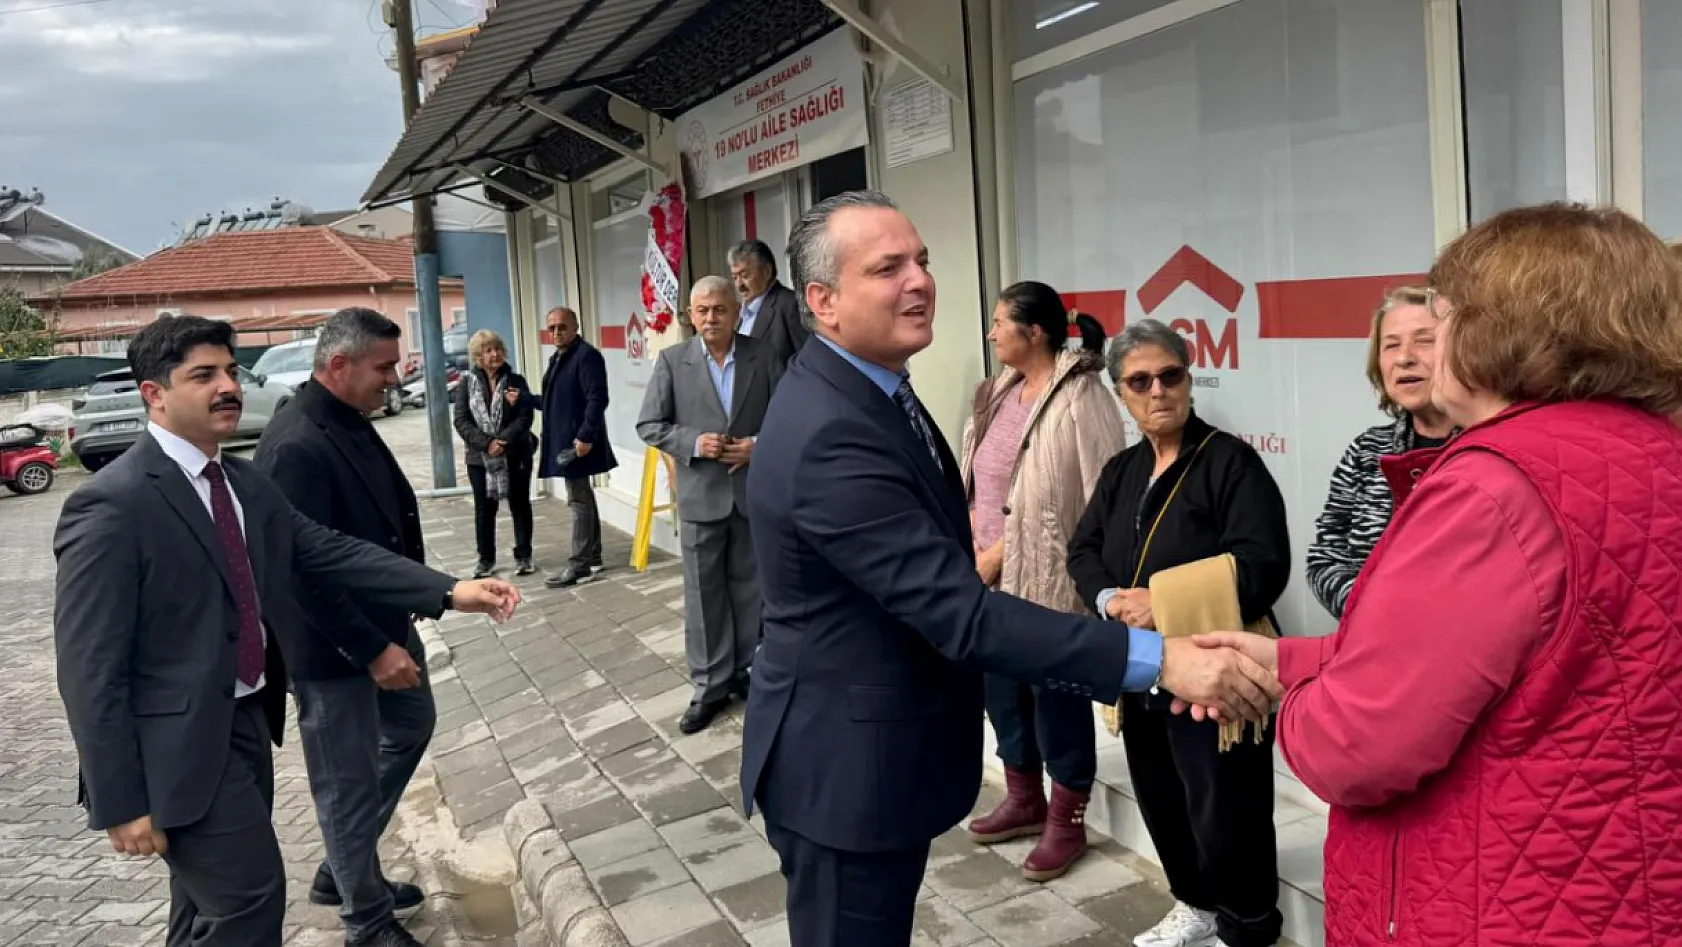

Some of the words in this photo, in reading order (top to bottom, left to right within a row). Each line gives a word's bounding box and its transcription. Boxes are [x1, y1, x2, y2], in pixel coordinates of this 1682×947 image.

[746, 77, 772, 101] SAĞLIK
[771, 54, 812, 88] BAKANLIĞI
[715, 139, 726, 159] 19
[728, 124, 757, 154] NO'LU
[761, 112, 787, 139] AİLE
[790, 85, 845, 128] SAĞLIĞI
[748, 133, 799, 174] MERKEZİ
[1170, 318, 1239, 370] SM
